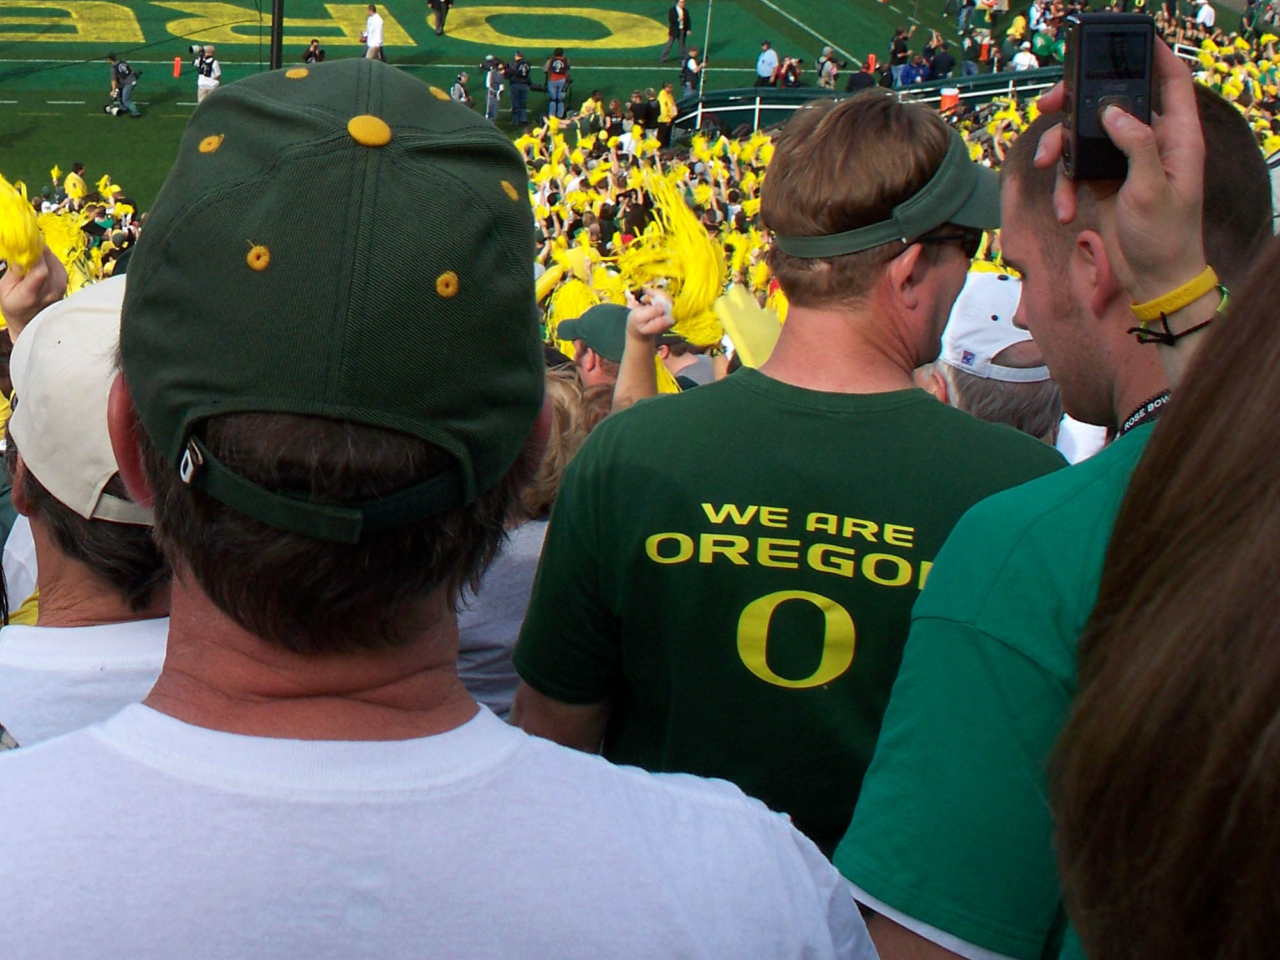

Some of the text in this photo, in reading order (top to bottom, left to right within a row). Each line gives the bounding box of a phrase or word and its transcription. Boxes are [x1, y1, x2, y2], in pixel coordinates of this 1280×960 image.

[1124, 394, 1172, 431] ROSE BOW
[700, 502, 916, 549] WE ARE
[736, 589, 857, 690] O
